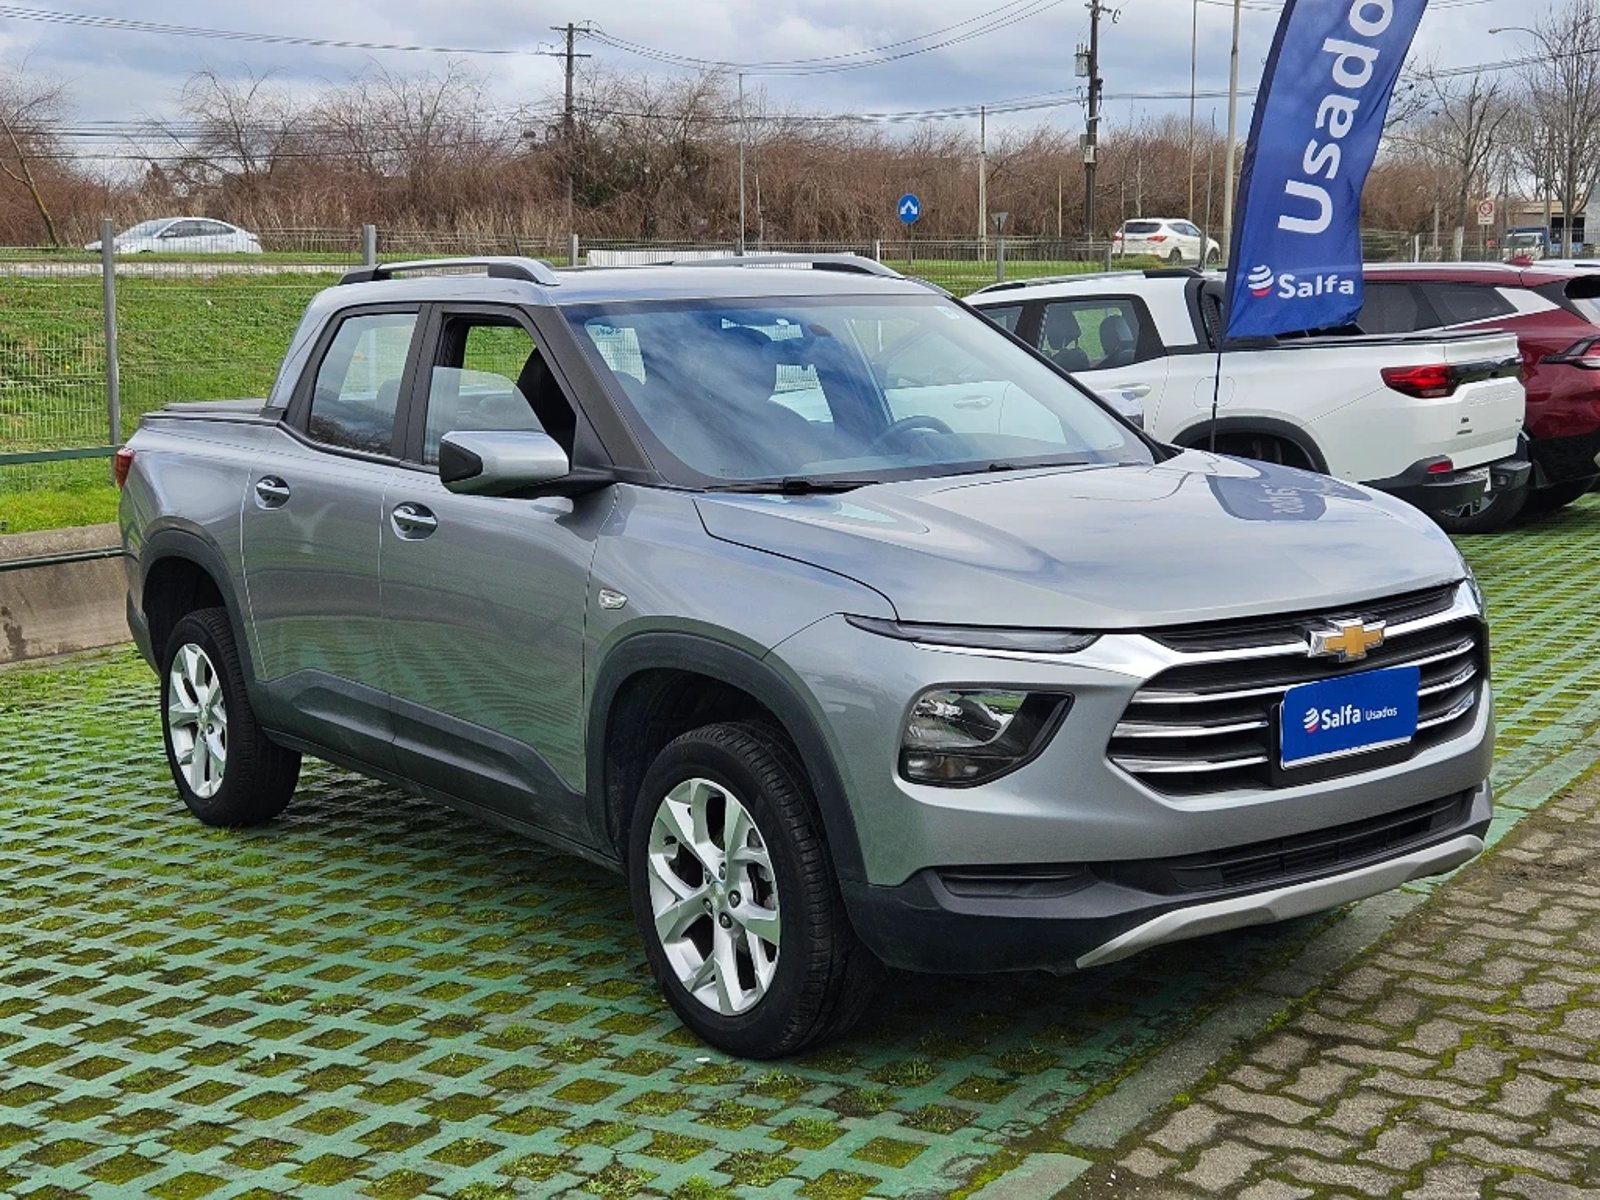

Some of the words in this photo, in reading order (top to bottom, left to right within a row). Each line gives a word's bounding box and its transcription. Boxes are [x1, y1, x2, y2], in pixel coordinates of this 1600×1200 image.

[1278, 273, 1354, 298] Salfa
[1321, 704, 1361, 730] Salfa
[1365, 706, 1398, 721] Usados
